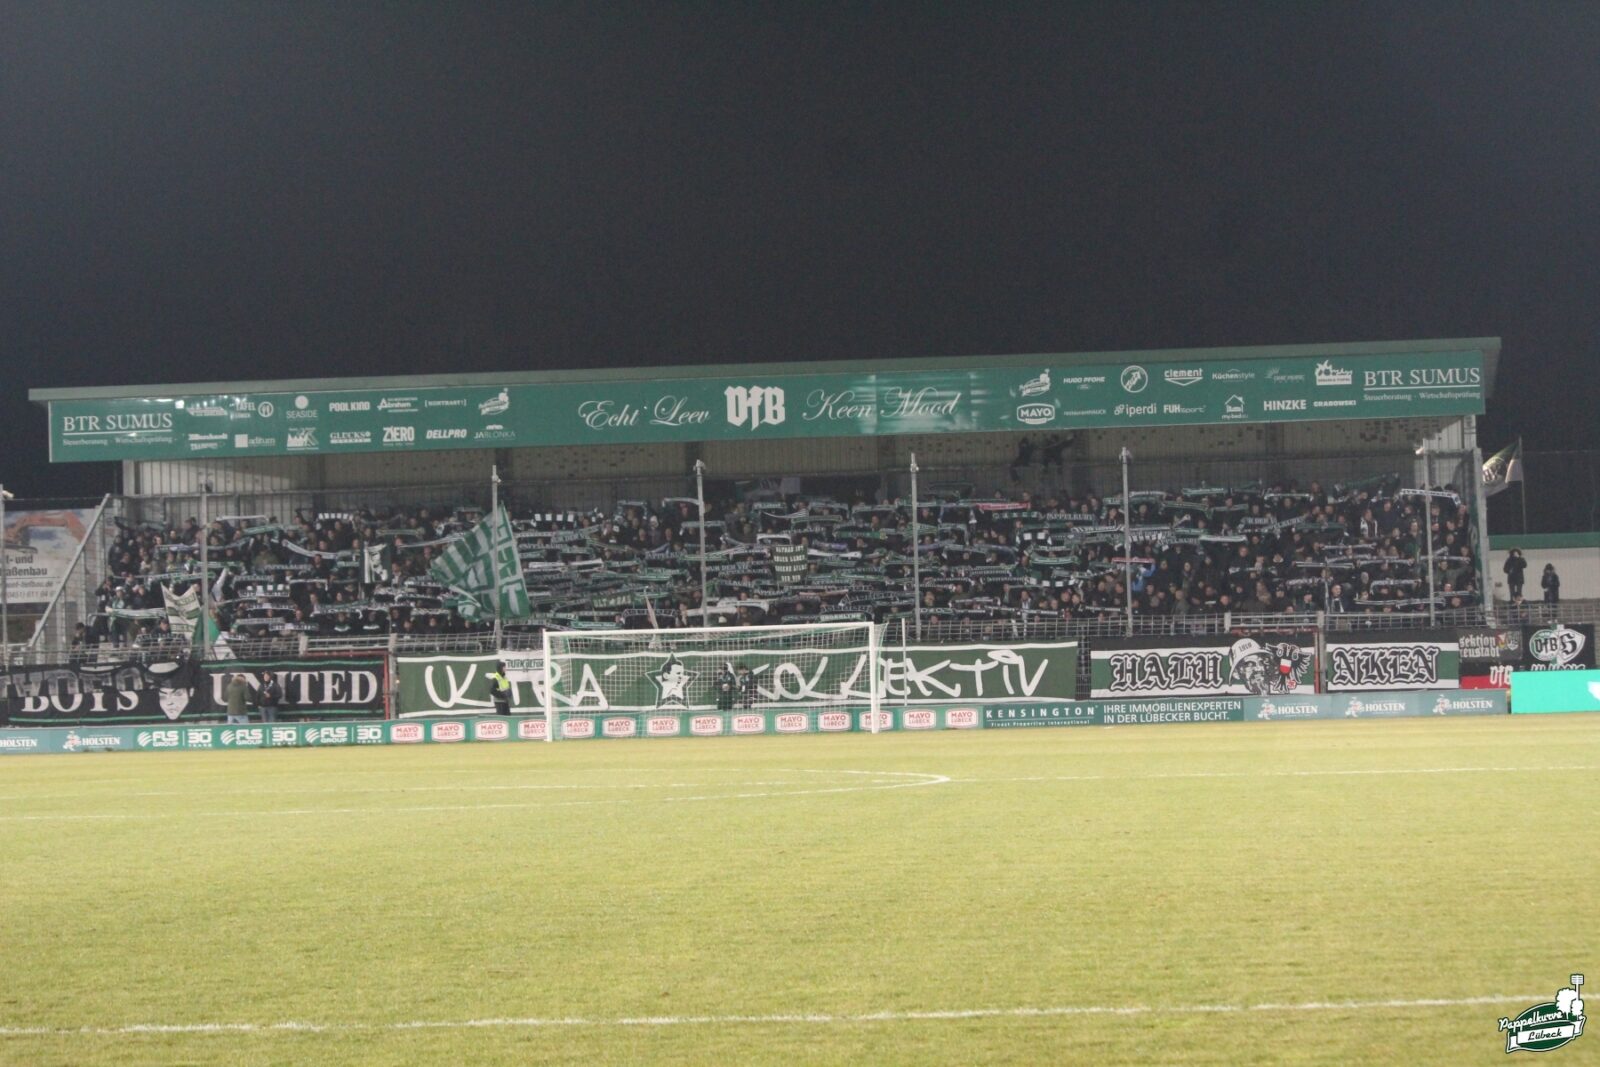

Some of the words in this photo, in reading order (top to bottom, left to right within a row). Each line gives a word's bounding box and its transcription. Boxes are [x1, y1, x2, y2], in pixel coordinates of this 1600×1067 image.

[1164, 368, 1203, 378] clement
[1365, 370, 1404, 387] BTR
[1410, 367, 1480, 385] SUMUS
[802, 389, 873, 420] Keen
[1263, 399, 1307, 411] HINZKE
[1313, 399, 1357, 408] GRABOWSKI
[286, 410, 318, 419] SEASIDE
[1020, 408, 1052, 418] MAYO
[1126, 403, 1157, 417] iperdi
[63, 416, 101, 432] BTR
[106, 413, 173, 431] SUMUS
[426, 429, 467, 440] DELLPRO
[15, 555, 33, 565] und
[5, 566, 48, 577] aßenbau
[1459, 633, 1497, 649] sektion
[1103, 704, 1127, 714] IHRE
[1129, 700, 1241, 712] IMMOBILIENEXPERTEN
[1277, 704, 1318, 715] HOLSTEN
[1365, 702, 1406, 712] HOLSTEN
[1453, 700, 1493, 710] HOLSTEN
[986, 706, 1095, 719] KENSINGTON
[1103, 714, 1114, 724] IN
[1117, 713, 1138, 723] DER
[1140, 711, 1192, 722] LÜBECKER
[1194, 711, 1230, 722] BUCHT.
[187, 731, 212, 743] 30
[272, 729, 297, 741] 30
[356, 727, 382, 739] 30
[81, 736, 121, 746] HOLSTEN
